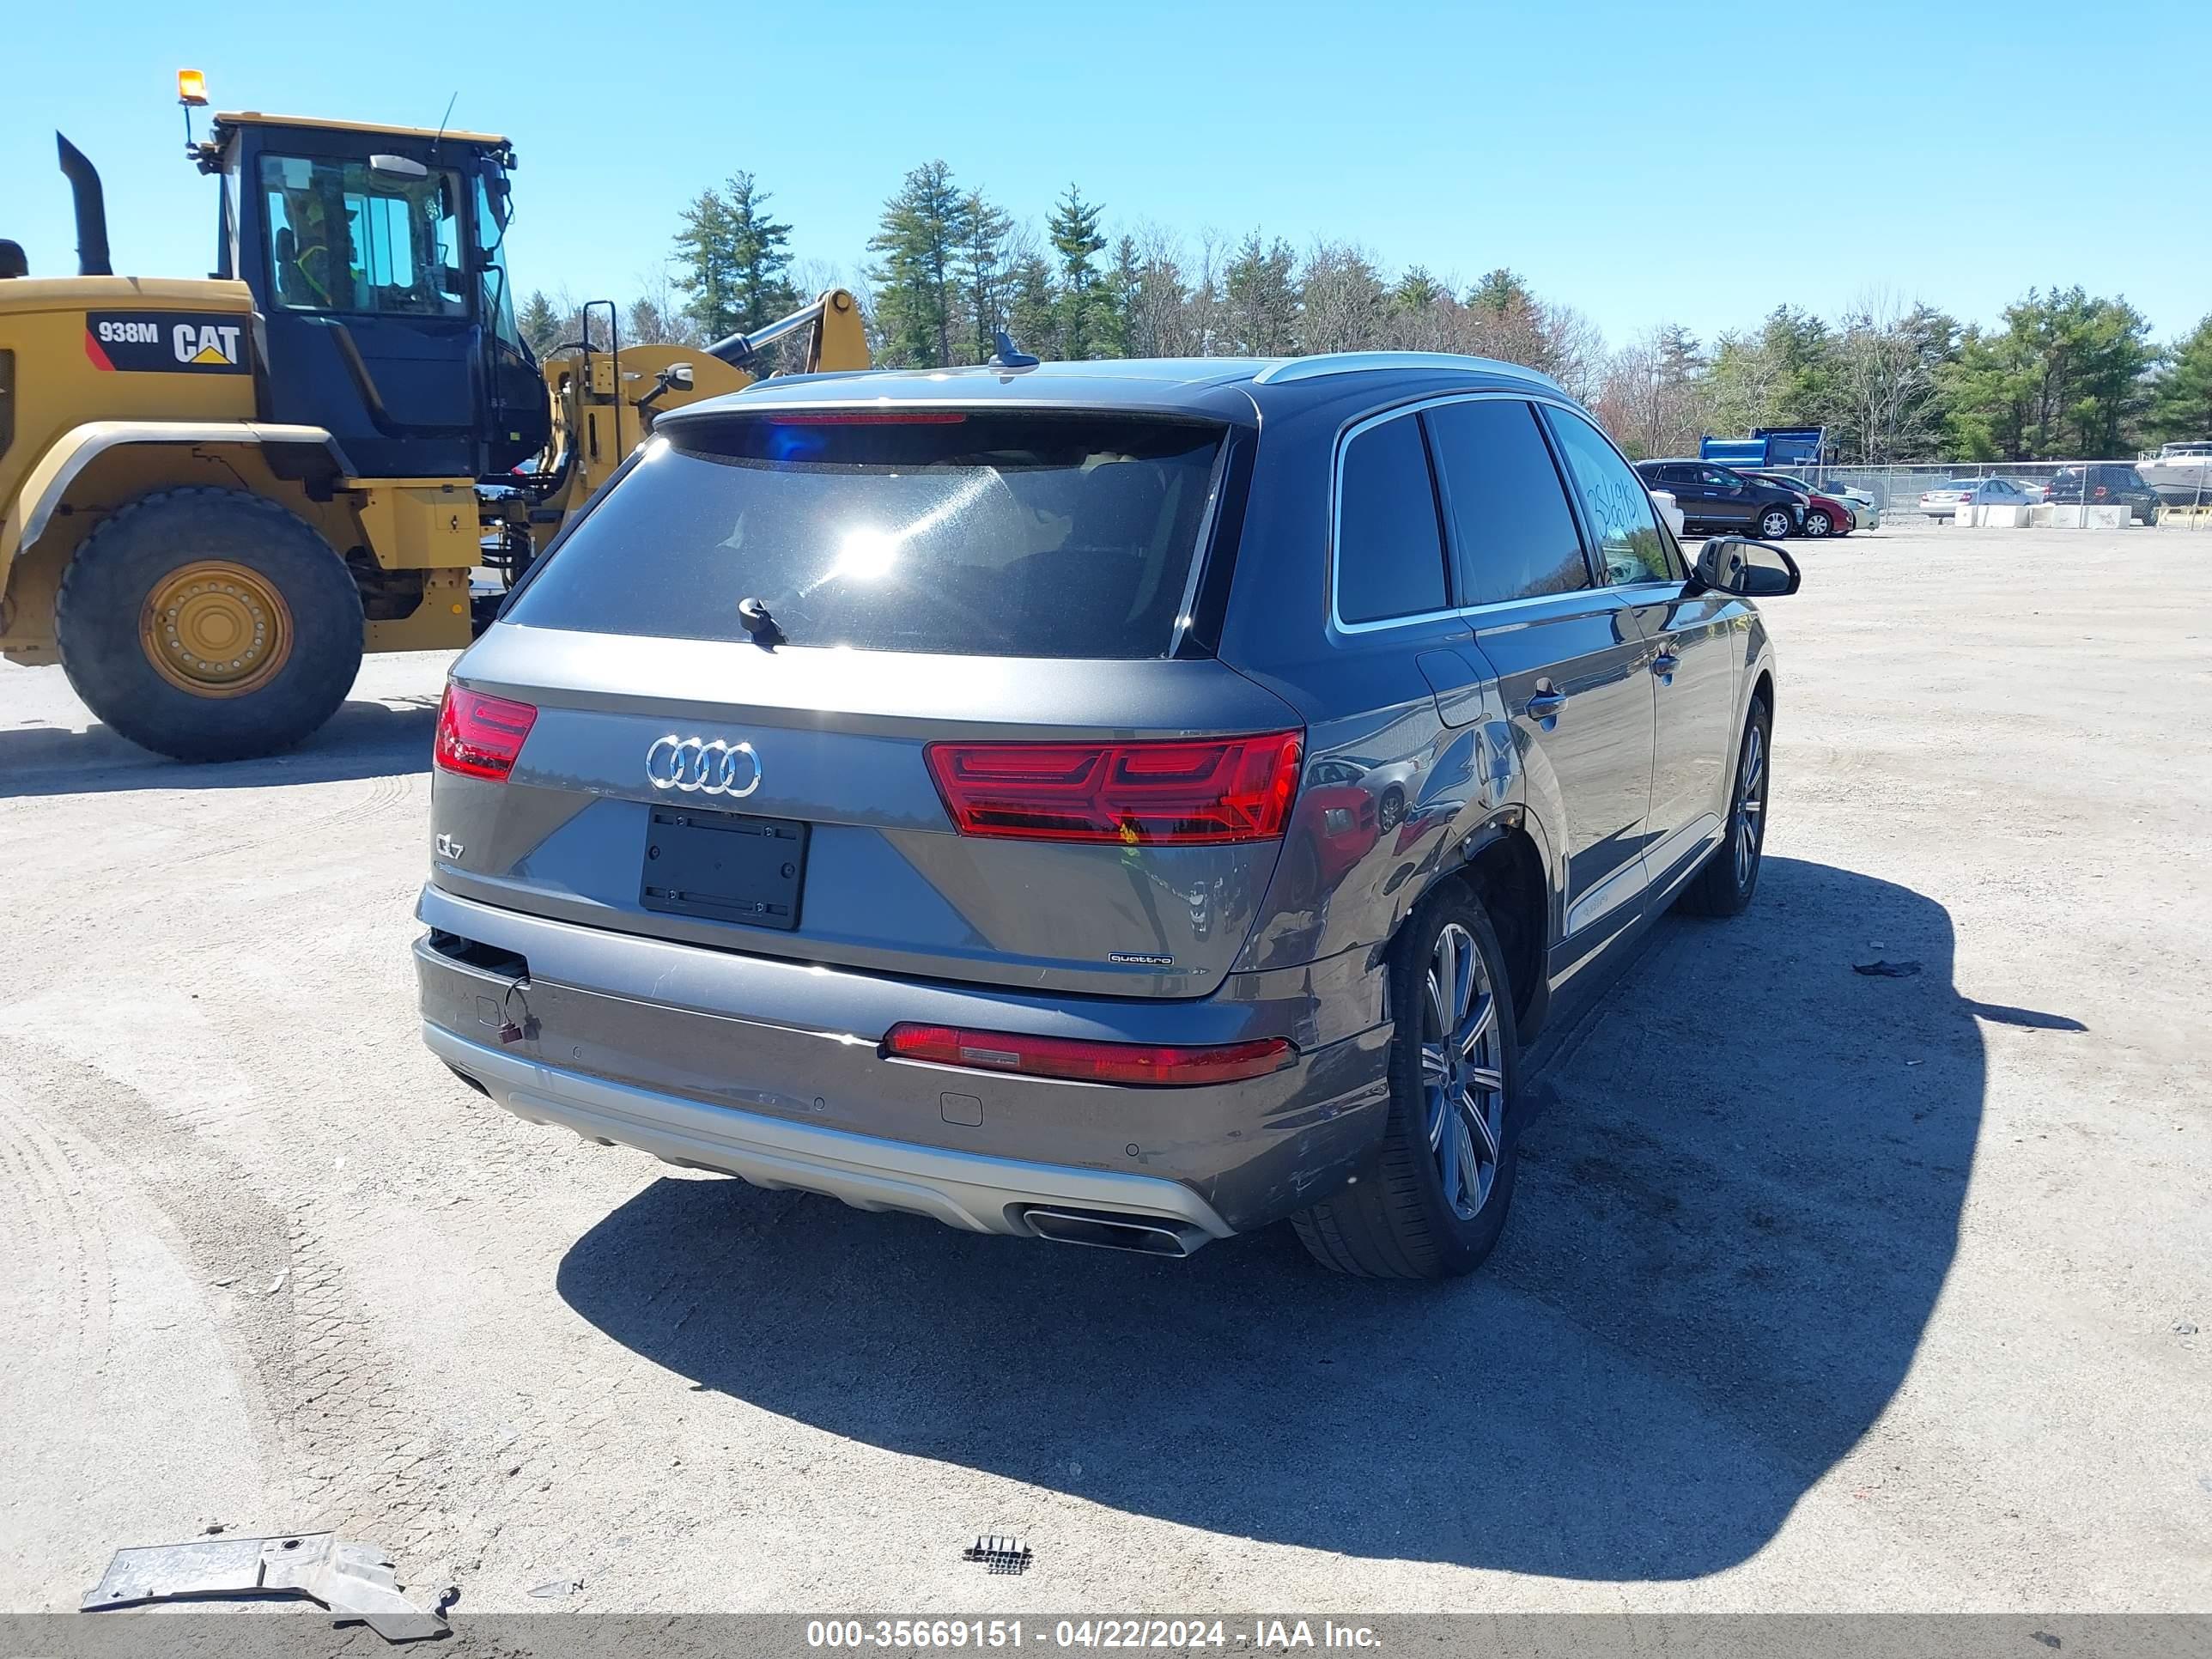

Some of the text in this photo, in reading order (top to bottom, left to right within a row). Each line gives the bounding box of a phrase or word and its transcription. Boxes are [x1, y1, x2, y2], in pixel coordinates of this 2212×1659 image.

[98, 321, 159, 343] 938M
[173, 324, 240, 365] CAT
[436, 833, 465, 859] Q7
[1110, 955, 1172, 964] quattro
